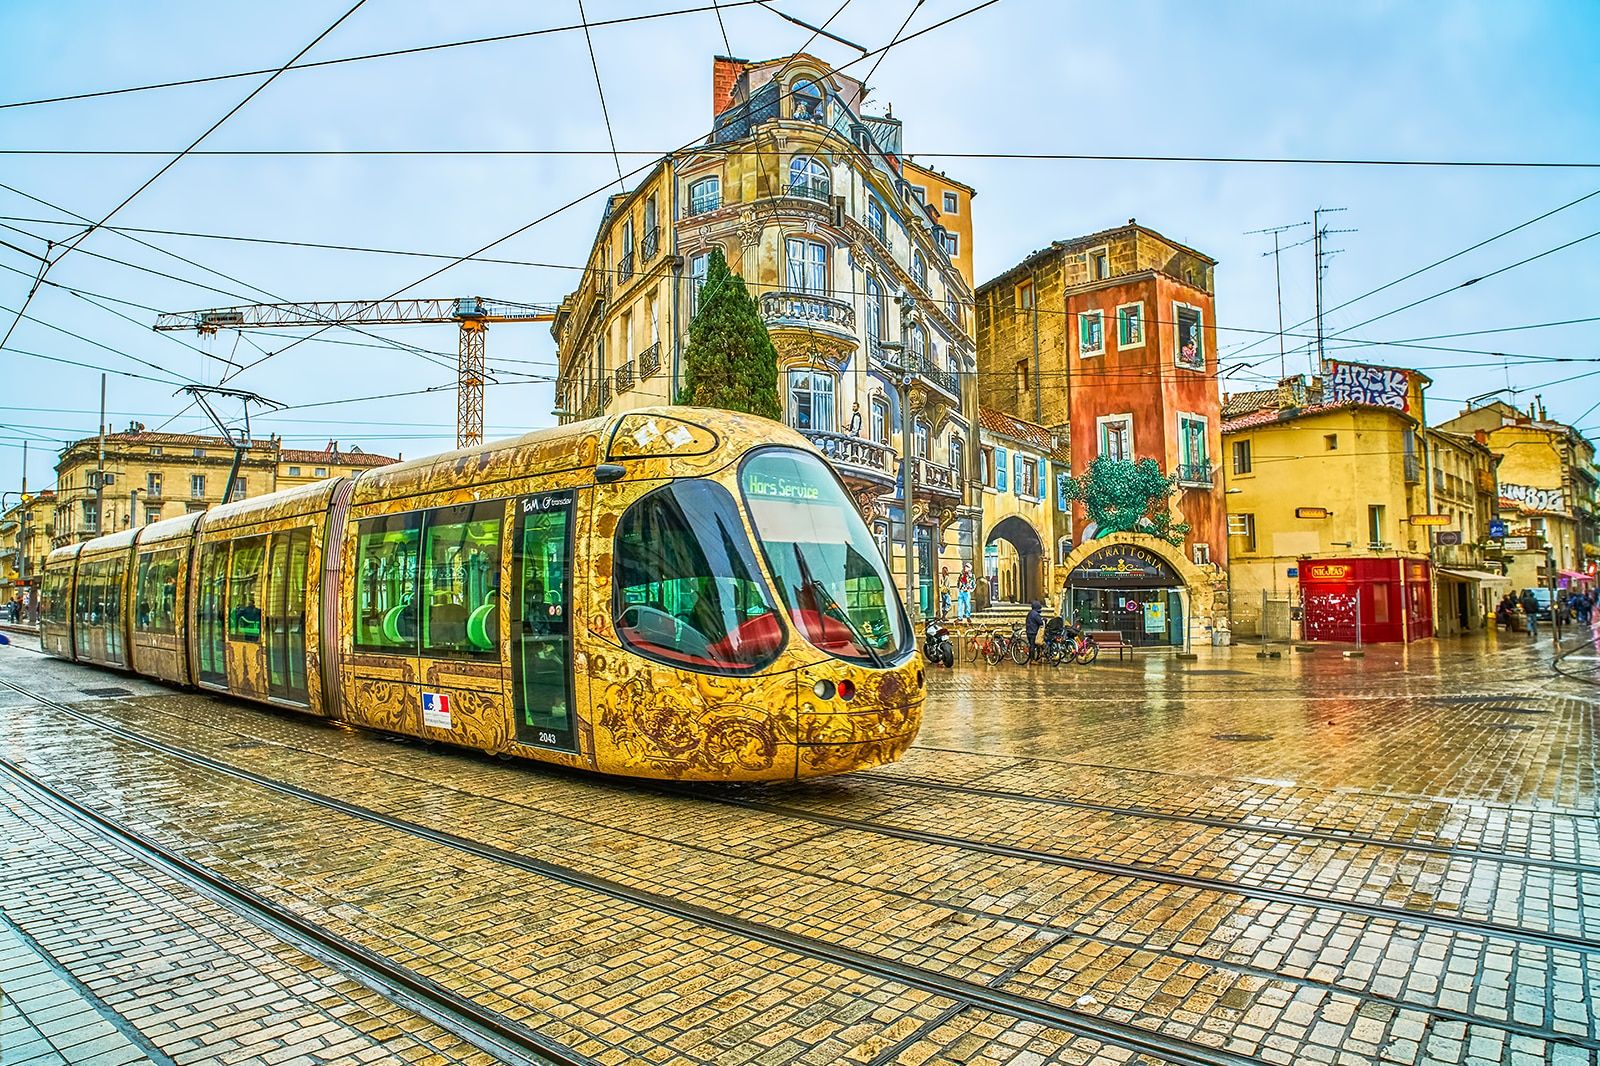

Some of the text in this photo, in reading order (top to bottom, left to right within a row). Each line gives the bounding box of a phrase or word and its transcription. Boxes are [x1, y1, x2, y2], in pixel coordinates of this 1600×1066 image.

[749, 474, 818, 499] Hors Service
[1097, 547, 1163, 572] TRATTORIA
[1313, 566, 1344, 577] NICOLAS
[539, 731, 556, 744] 2043
